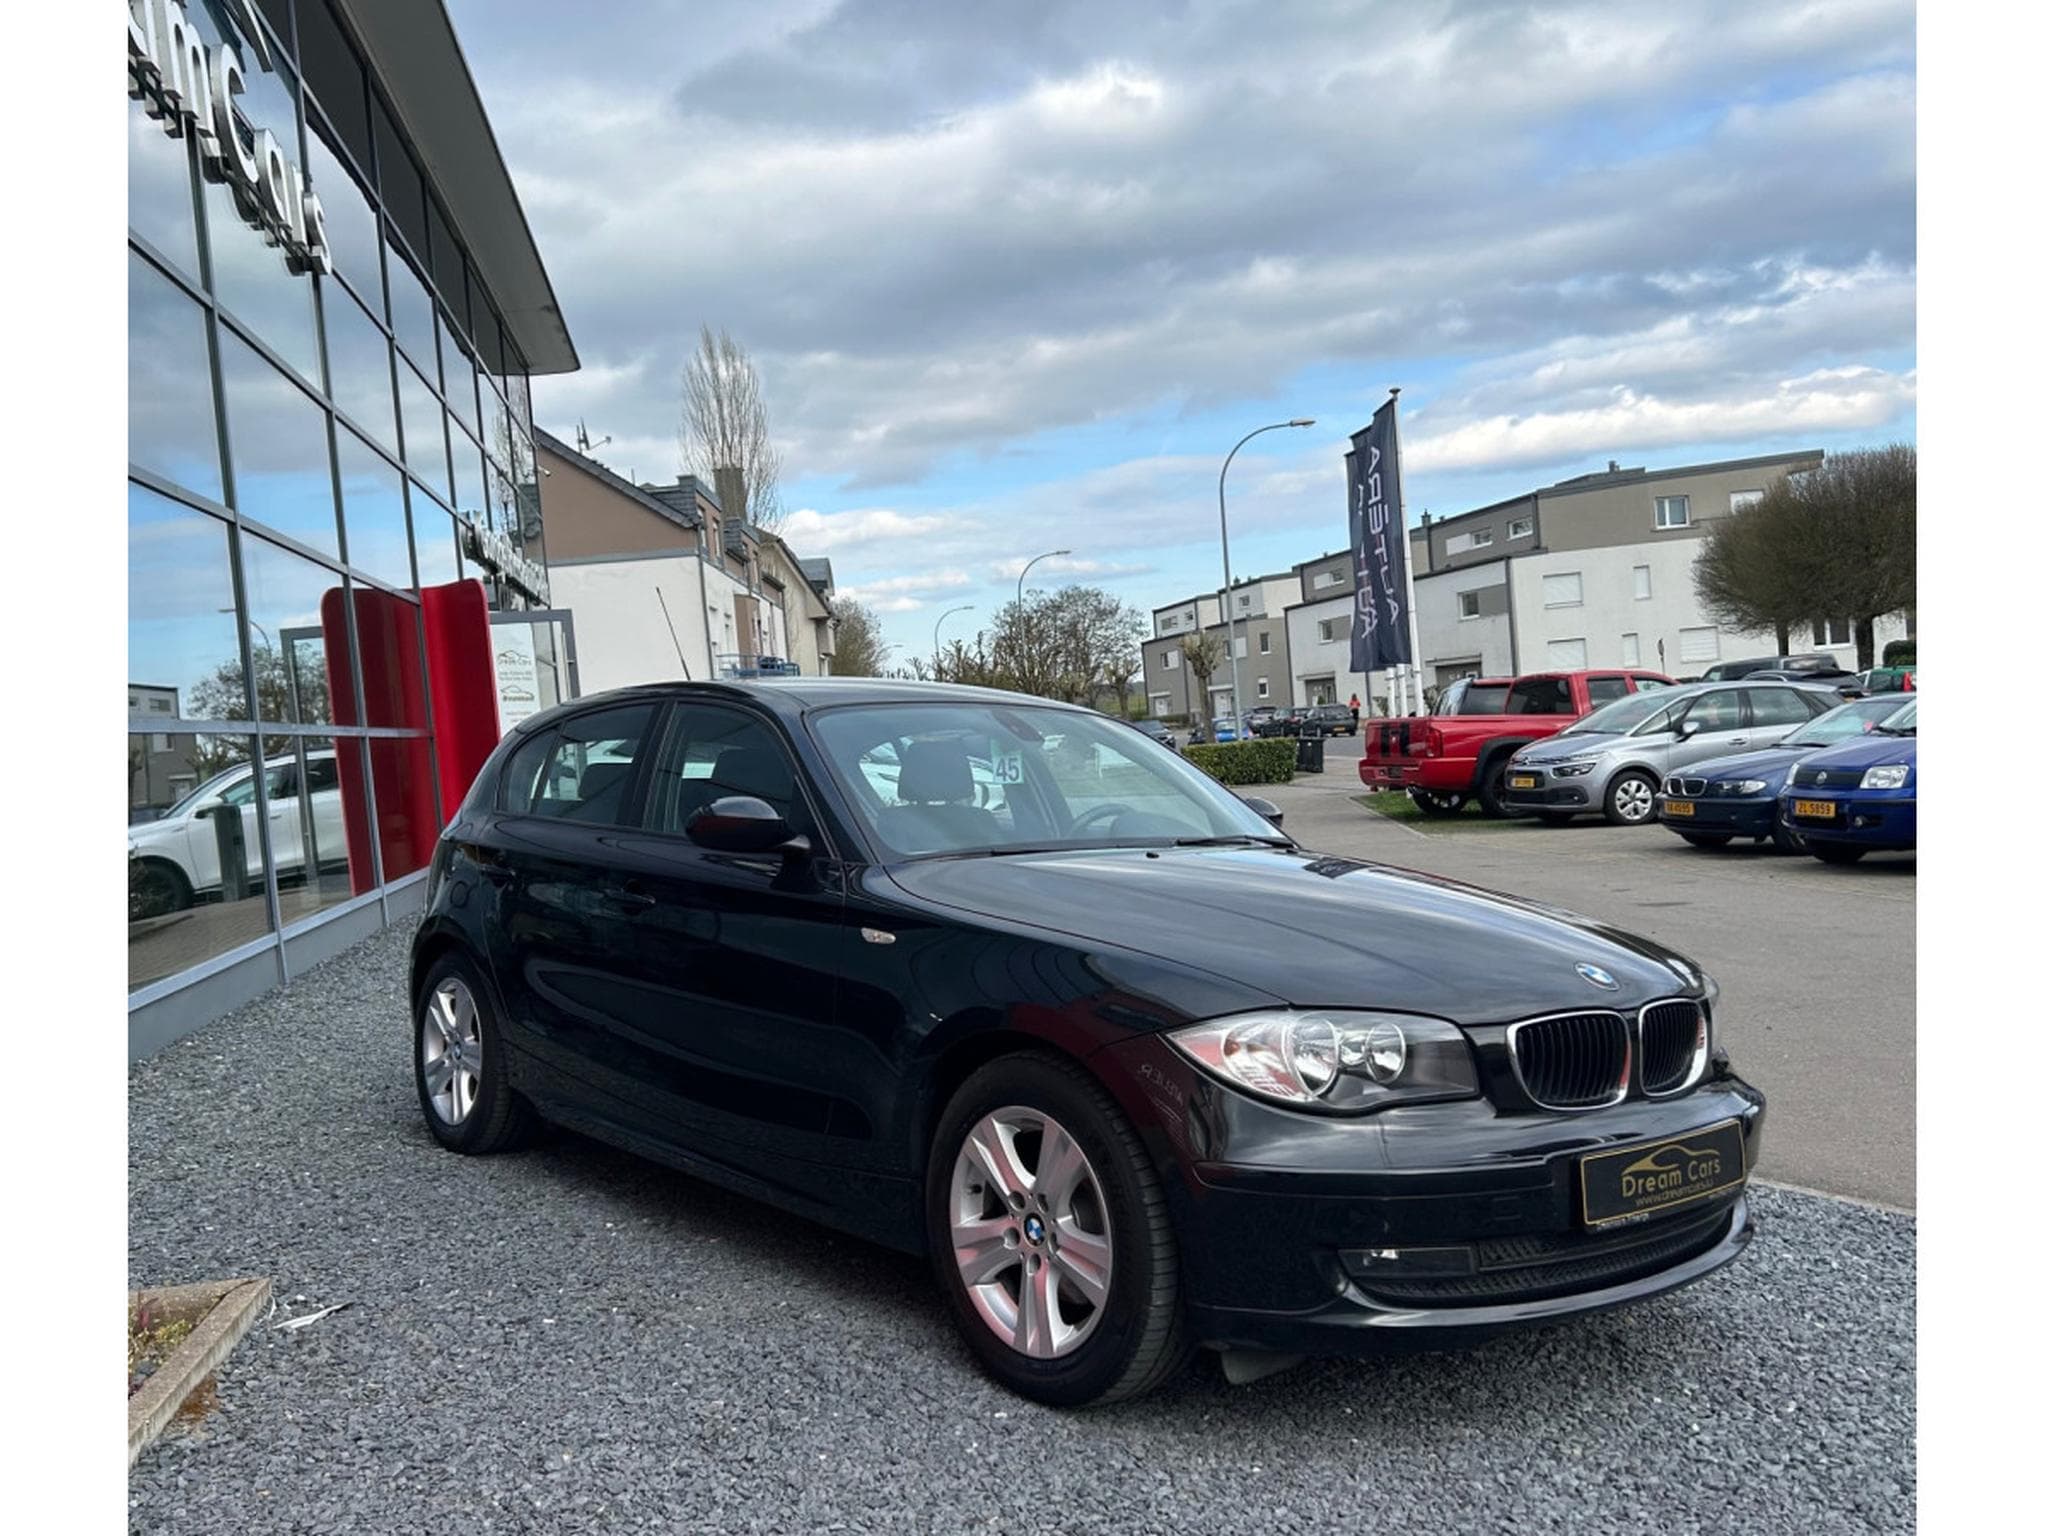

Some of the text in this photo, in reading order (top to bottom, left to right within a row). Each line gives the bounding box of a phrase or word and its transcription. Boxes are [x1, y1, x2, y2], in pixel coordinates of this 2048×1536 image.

[995, 757, 1020, 782] 45
[1622, 1169, 1682, 1198] Dream
[1687, 1159, 1722, 1181] Cars
